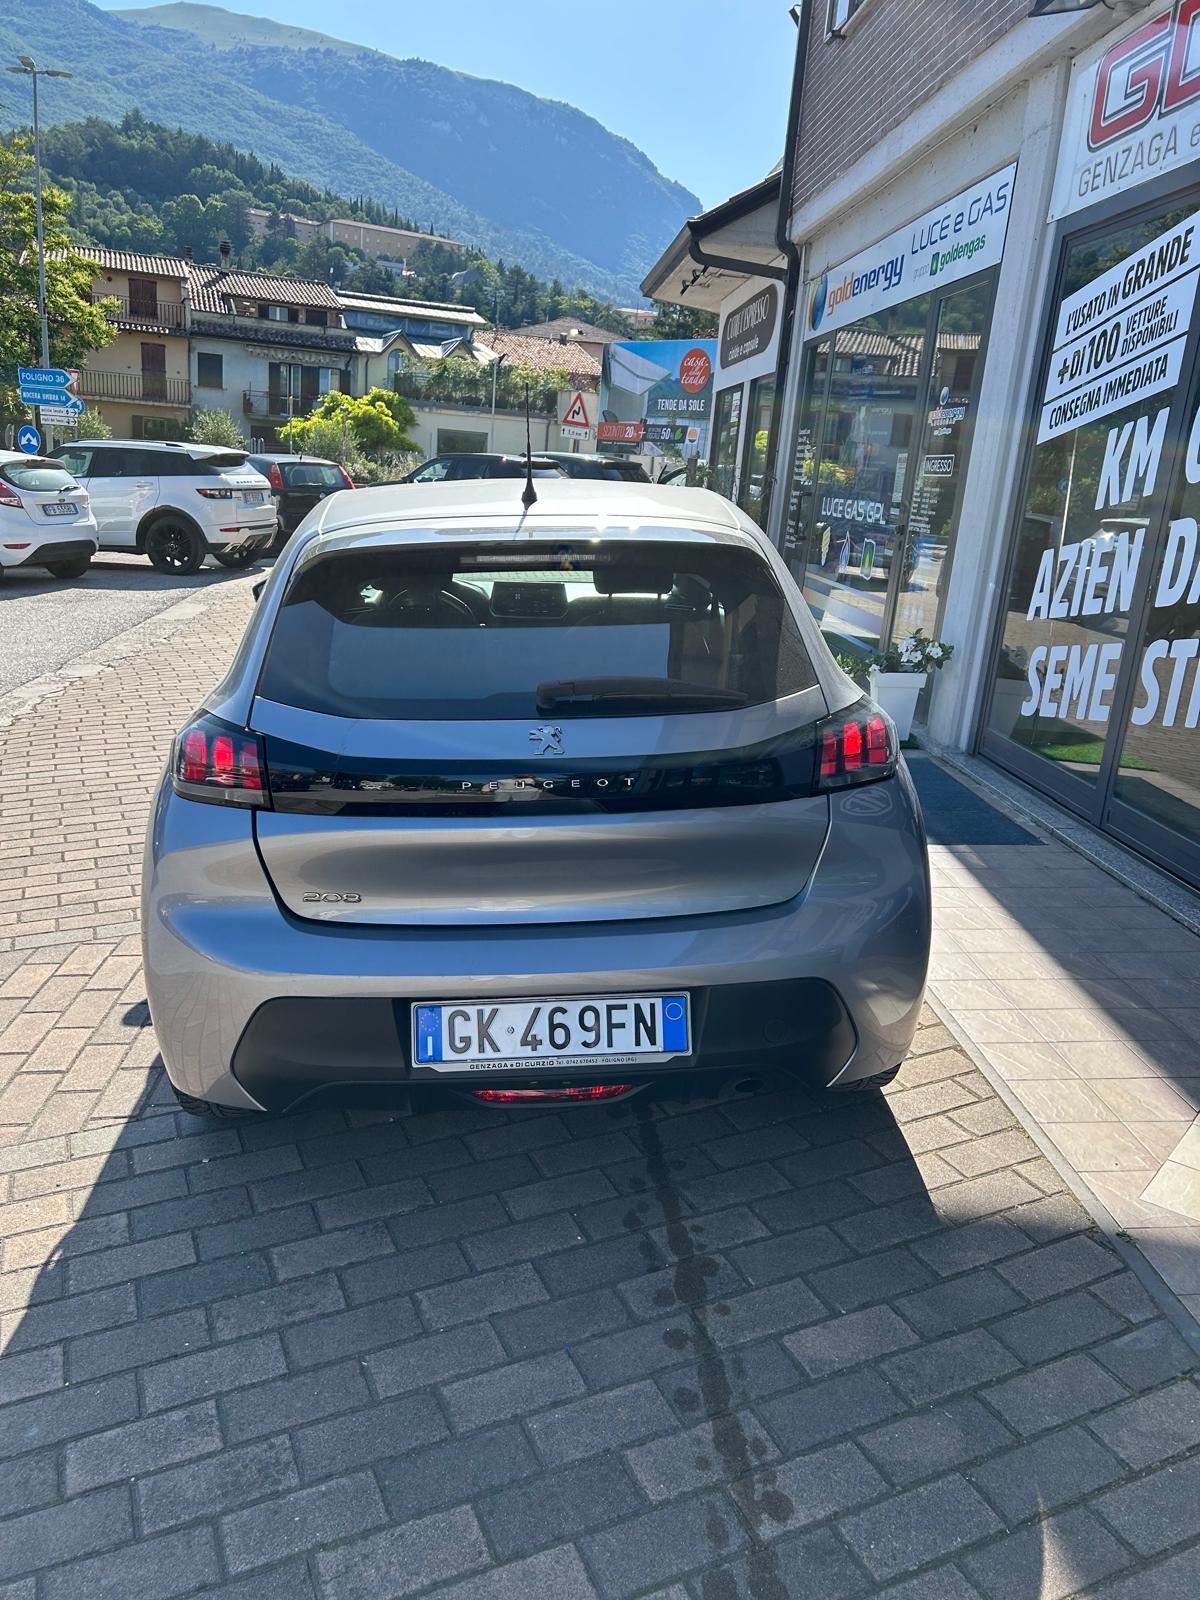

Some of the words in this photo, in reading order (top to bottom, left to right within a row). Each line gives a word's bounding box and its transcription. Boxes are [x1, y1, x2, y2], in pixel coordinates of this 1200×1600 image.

[1078, 125, 1178, 198] GENZAGA
[911, 215, 951, 255] LUCE
[953, 212, 964, 234] e
[967, 181, 1010, 226] GAS
[938, 233, 986, 271] goldengas
[826, 253, 905, 317] goldenergy
[1065, 291, 1106, 336] L'USATO
[1106, 281, 1121, 311] IN
[1121, 225, 1195, 300] GRANDE
[1120, 309, 1180, 358] DISPONIBILI
[1125, 295, 1169, 335] VETTURE
[1085, 321, 1122, 375] 100
[21, 372, 54, 382] FOLIGNO
[1048, 383, 1102, 430] CONSEGNA
[1102, 353, 1169, 406] IMMEDIATA
[657, 399, 677, 411] TENDE
[678, 400, 687, 411] DA
[688, 400, 706, 412] SOLE
[924, 459, 952, 472] INGRESSO
[1094, 406, 1171, 511] KM
[821, 496, 844, 518] LUCE
[844, 500, 865, 521] GAS
[866, 501, 886, 525] GPL
[461, 777, 635, 791] PEUGEOT
[302, 891, 362, 904] 208
[448, 1007, 500, 1054] GK
[519, 1002, 657, 1052] 469FN
[469, 1062, 509, 1070] GENZAGA
